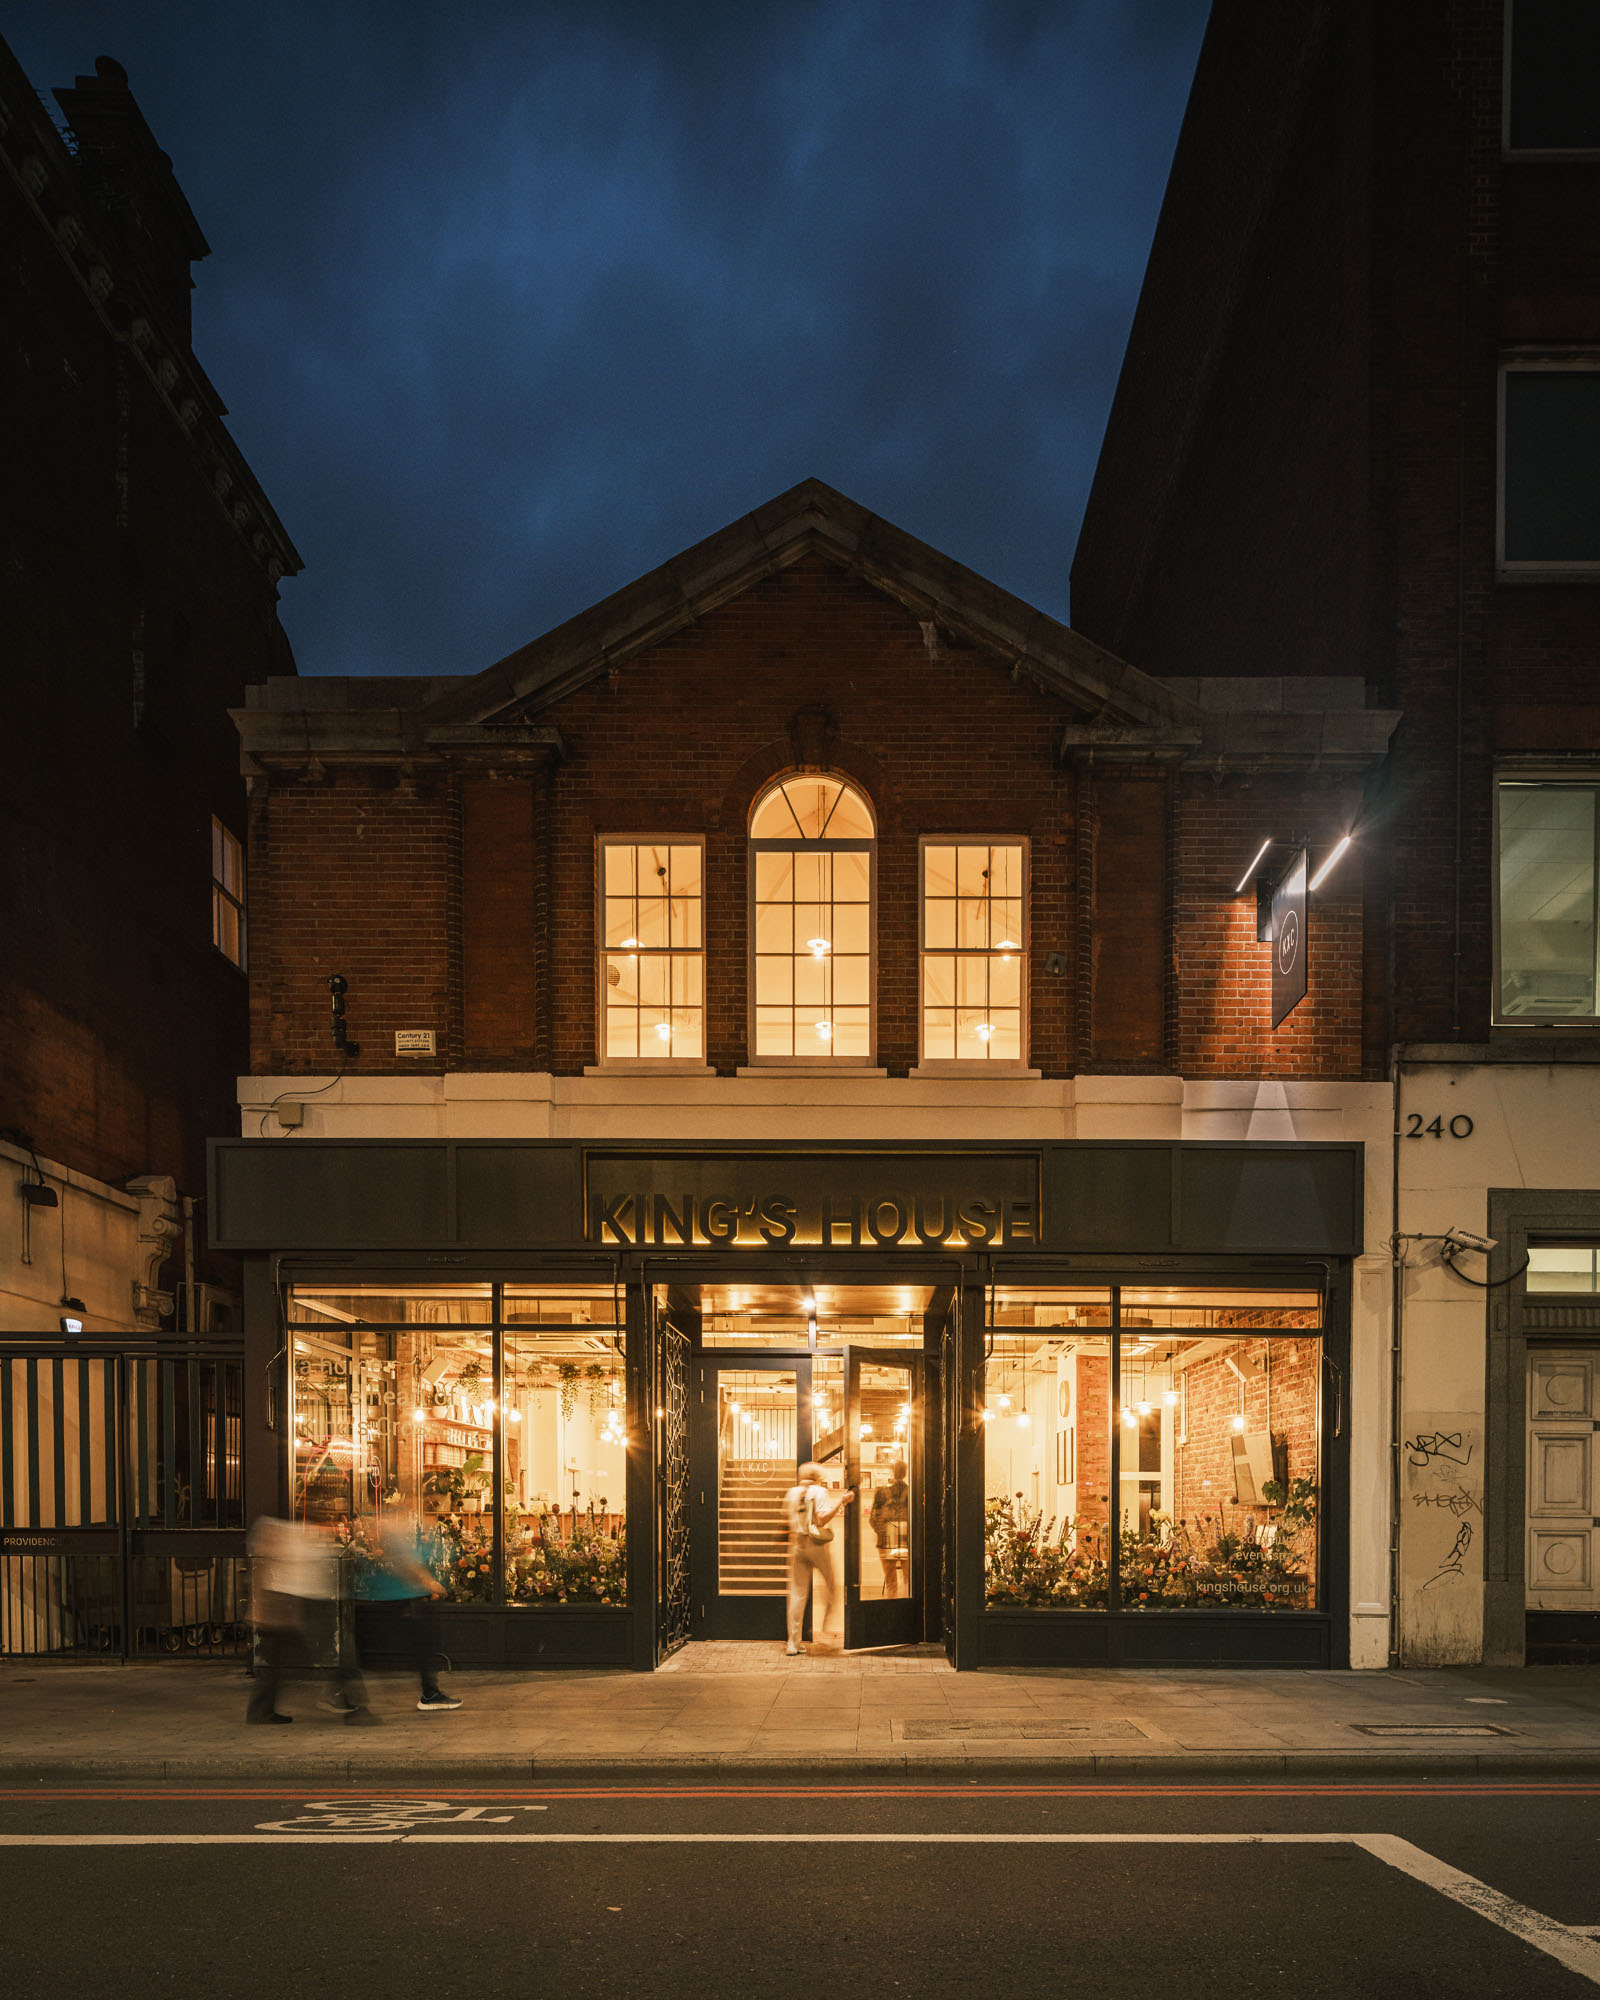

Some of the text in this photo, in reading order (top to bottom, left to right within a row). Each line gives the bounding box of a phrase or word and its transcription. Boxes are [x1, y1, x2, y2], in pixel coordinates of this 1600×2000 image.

[1282, 928, 1295, 957] KXC
[397, 1032, 422, 1040] Century
[1405, 1113, 1474, 1139] 240
[593, 1194, 1034, 1246] KING'S HOUSE
[300, 1360, 312, 1376] a
[328, 1385, 361, 1406] the
[434, 1384, 457, 1406] of
[748, 1462, 768, 1473] KXC
[1196, 1580, 1309, 1596] kingshouse.org.uk
